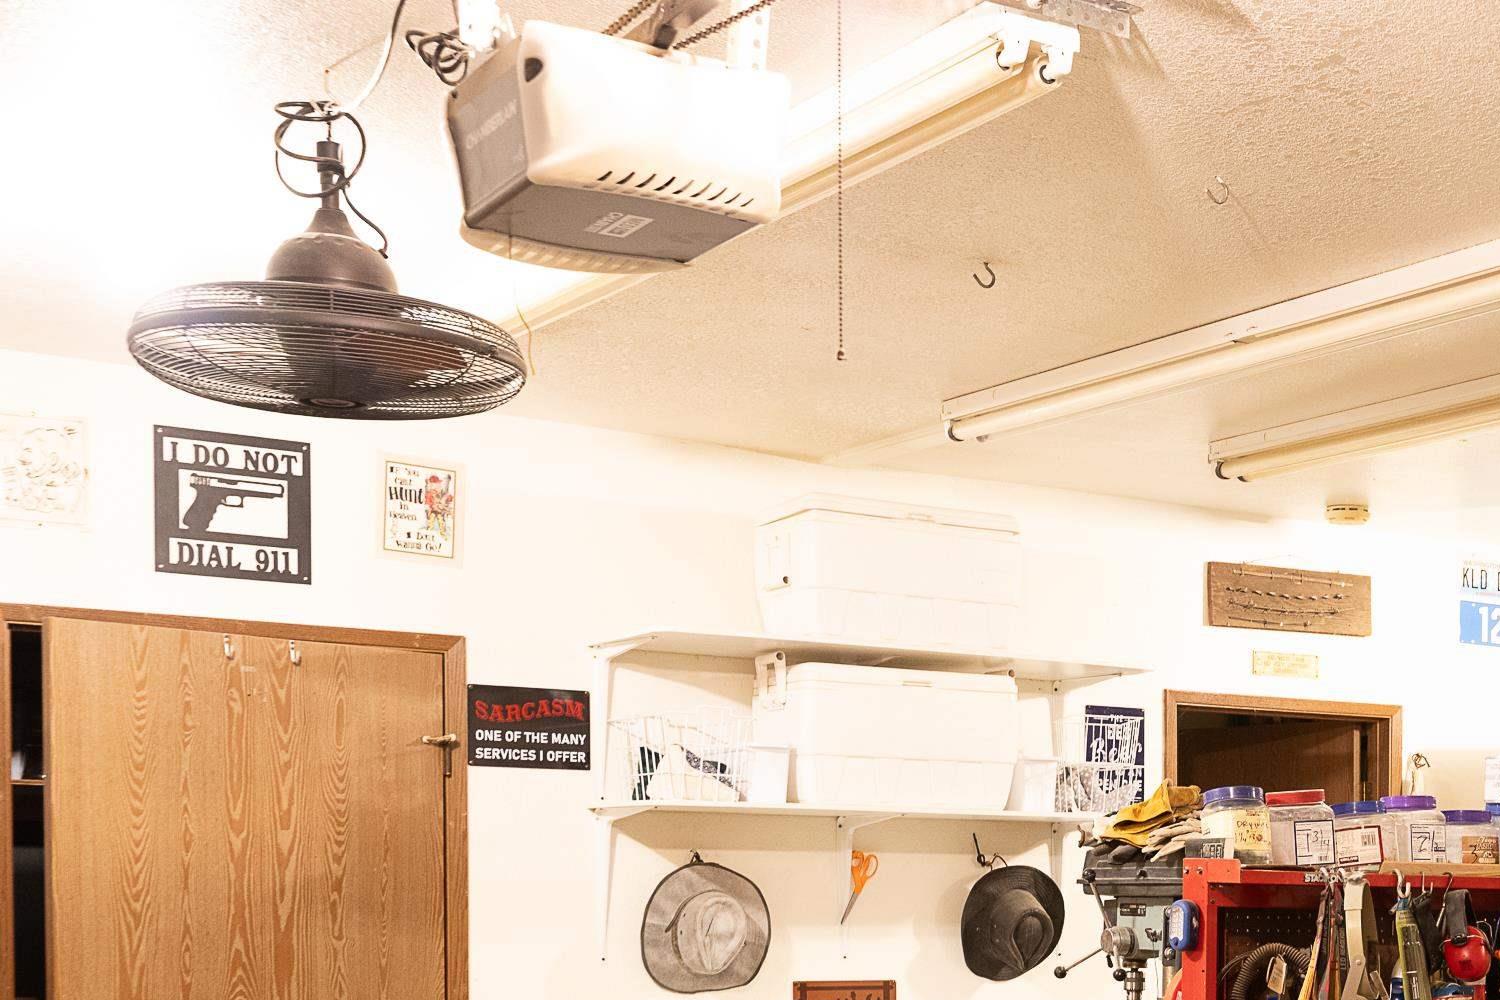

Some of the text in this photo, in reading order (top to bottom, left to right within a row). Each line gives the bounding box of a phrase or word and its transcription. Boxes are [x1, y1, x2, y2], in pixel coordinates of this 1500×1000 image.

[171, 442, 298, 475] I DO NOT
[177, 541, 292, 574] DIAL 911
[1462, 567, 1488, 590] KLD
[474, 698, 585, 722] SARCASM
[475, 729, 587, 745] ONE OF THE MANY
[475, 747, 586, 763] SERVICES I OFFER
